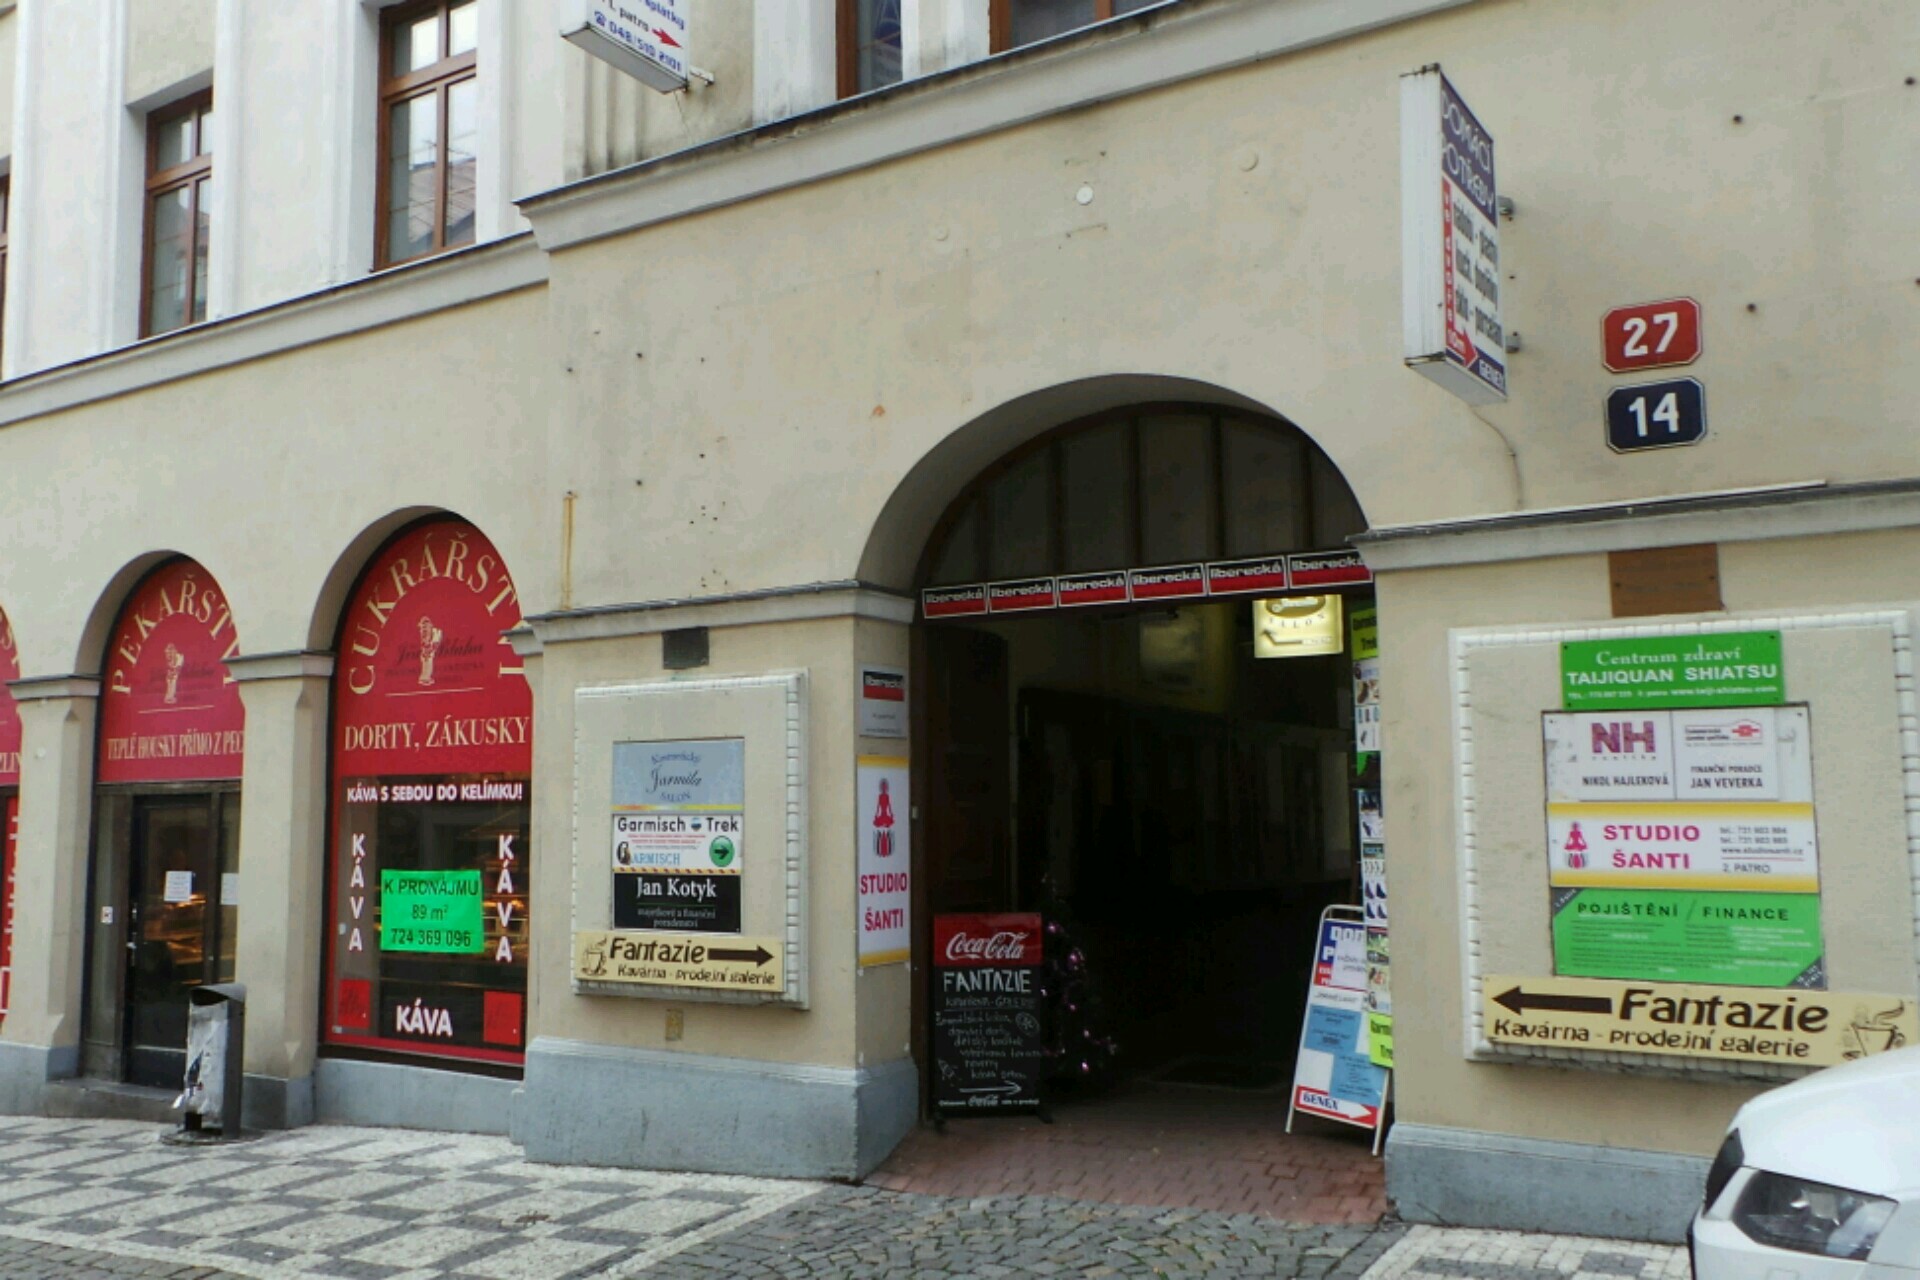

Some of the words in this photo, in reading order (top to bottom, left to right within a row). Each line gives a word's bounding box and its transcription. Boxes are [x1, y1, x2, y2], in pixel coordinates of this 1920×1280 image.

[1623, 312, 1679, 358] 27
[1628, 393, 1680, 437] 14
[1132, 568, 1202, 585] liberecká
[1210, 561, 1283, 578] liberecká
[990, 582, 1052, 598] liberecká
[1060, 574, 1125, 592] liberecká
[112, 574, 240, 695] PEKAŘST
[1596, 650, 1677, 666] Centrum
[1683, 644, 1741, 663] zdraví
[1566, 668, 1674, 686] TAIJIQUAN
[1684, 663, 1777, 682] SHIATSU
[214, 732, 222, 755] Z
[344, 723, 420, 752] DORTY,
[425, 715, 530, 748] ZÁKUSKY
[1591, 721, 1656, 754] NH
[347, 782, 378, 803] KÁVA
[381, 787, 389, 801] S
[392, 784, 433, 801] SEBOU
[437, 782, 457, 800] DO
[461, 779, 523, 801] KELÍMKU!
[1690, 778, 1711, 788] JAN
[1714, 777, 1763, 788] VEVERKA
[617, 816, 686, 833] Garmisch
[706, 816, 739, 833] Trek
[1603, 824, 1701, 842] STUDIO
[1612, 849, 1690, 870] ŠANTI
[1733, 863, 1771, 874] PATRO
[348, 833, 366, 951] KÁVA
[384, 879, 394, 894] K
[398, 875, 479, 897] PRONÁJMU
[636, 876, 662, 898] Jan
[667, 878, 716, 902] Kotyk
[860, 873, 907, 895] STUDIO
[495, 834, 514, 963] KÁVA
[412, 904, 427, 920] 89
[864, 906, 904, 932] ŠANTI
[1577, 902, 1679, 918] POJIŠTĚNÍ
[1703, 906, 1789, 921] FINANCE
[391, 928, 413, 945] 724
[418, 930, 441, 946] 369
[446, 930, 471, 947] 096
[609, 937, 706, 964] Fantazie
[617, 963, 666, 980] Kavárna
[675, 967, 728, 983] prodejní
[729, 970, 775, 985] galerie
[943, 967, 1032, 993] FANTAZIE
[396, 998, 453, 1037] KÁVA
[1620, 988, 1829, 1034] Fantazie
[1494, 1018, 1590, 1042] Kavárna
[1610, 1029, 1716, 1051] prodejní
[1719, 1035, 1810, 1058] galerie
